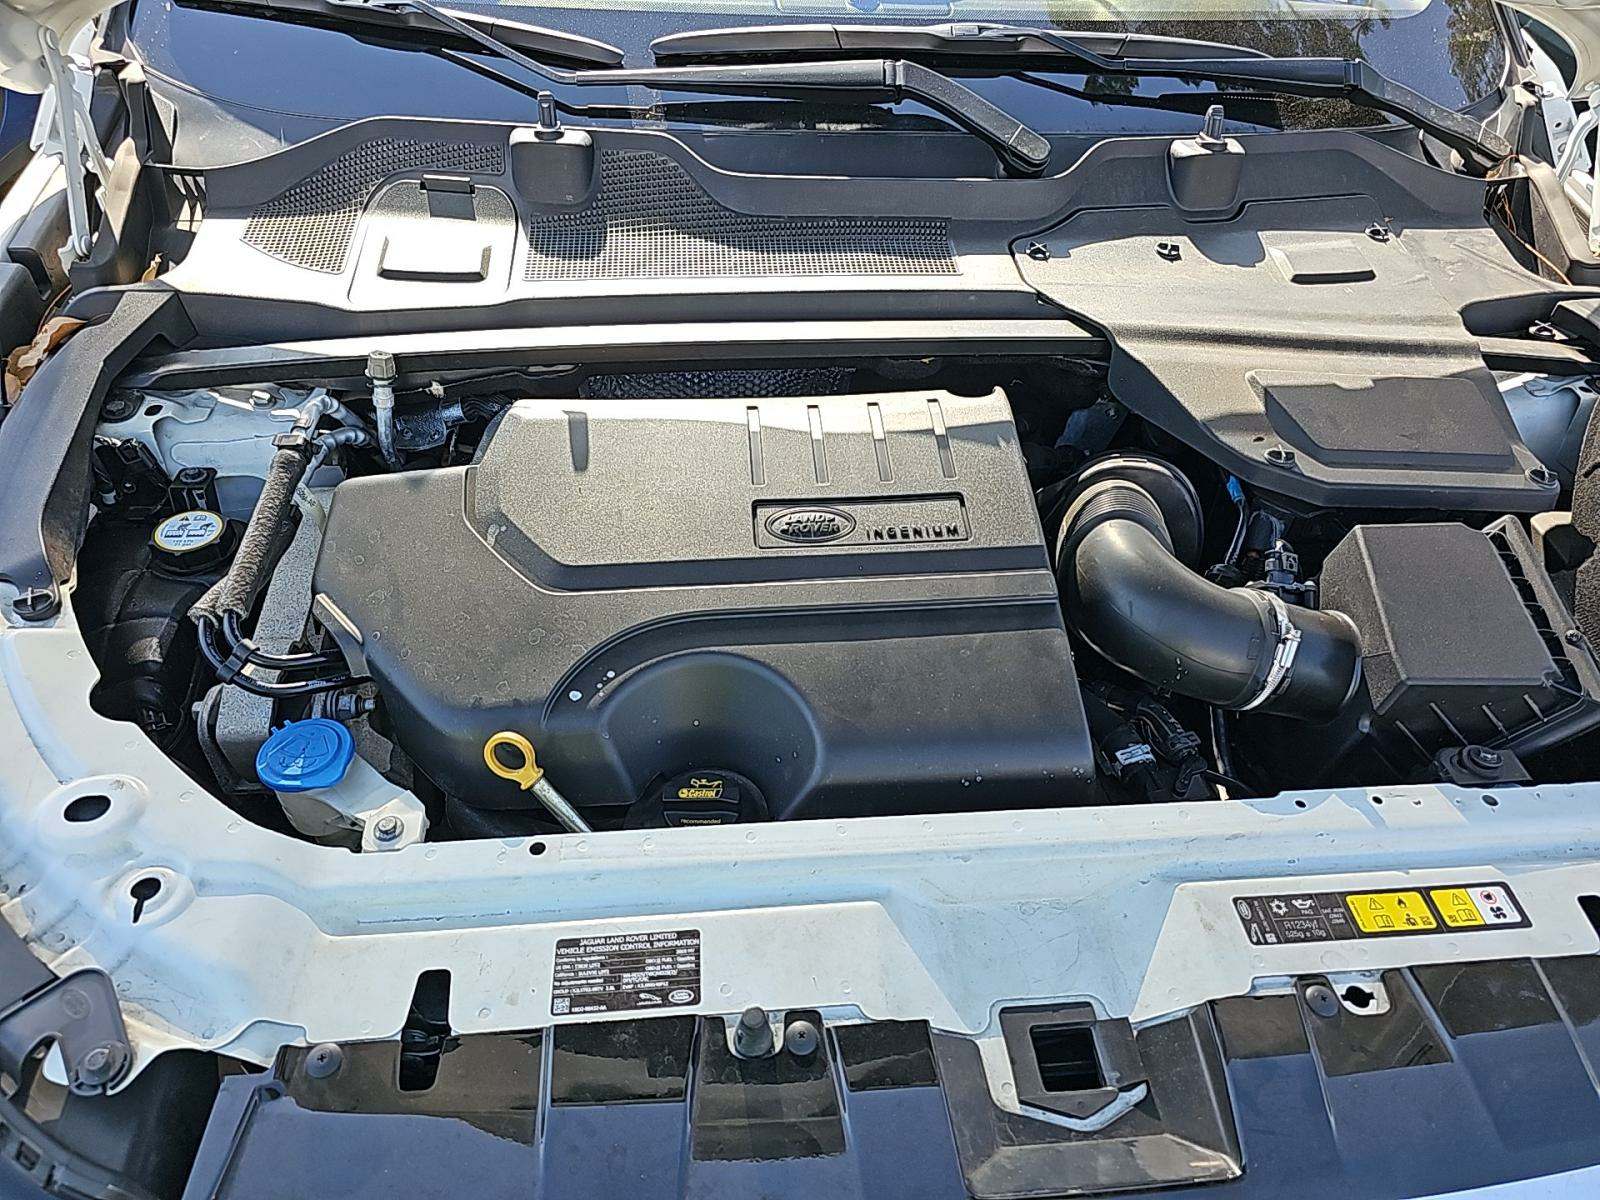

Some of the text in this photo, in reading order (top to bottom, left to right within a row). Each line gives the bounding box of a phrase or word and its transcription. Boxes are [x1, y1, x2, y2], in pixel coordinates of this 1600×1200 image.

[787, 514, 825, 523] LAND
[788, 522, 840, 534] ROVER
[866, 524, 959, 541] INGENIUM
[688, 788, 716, 798] Castrol
[580, 932, 677, 946] JAGUAR LAND ROVER LIMITED
[556, 938, 700, 955] VEHICLE EMISSION CONTROL INFORMATION
